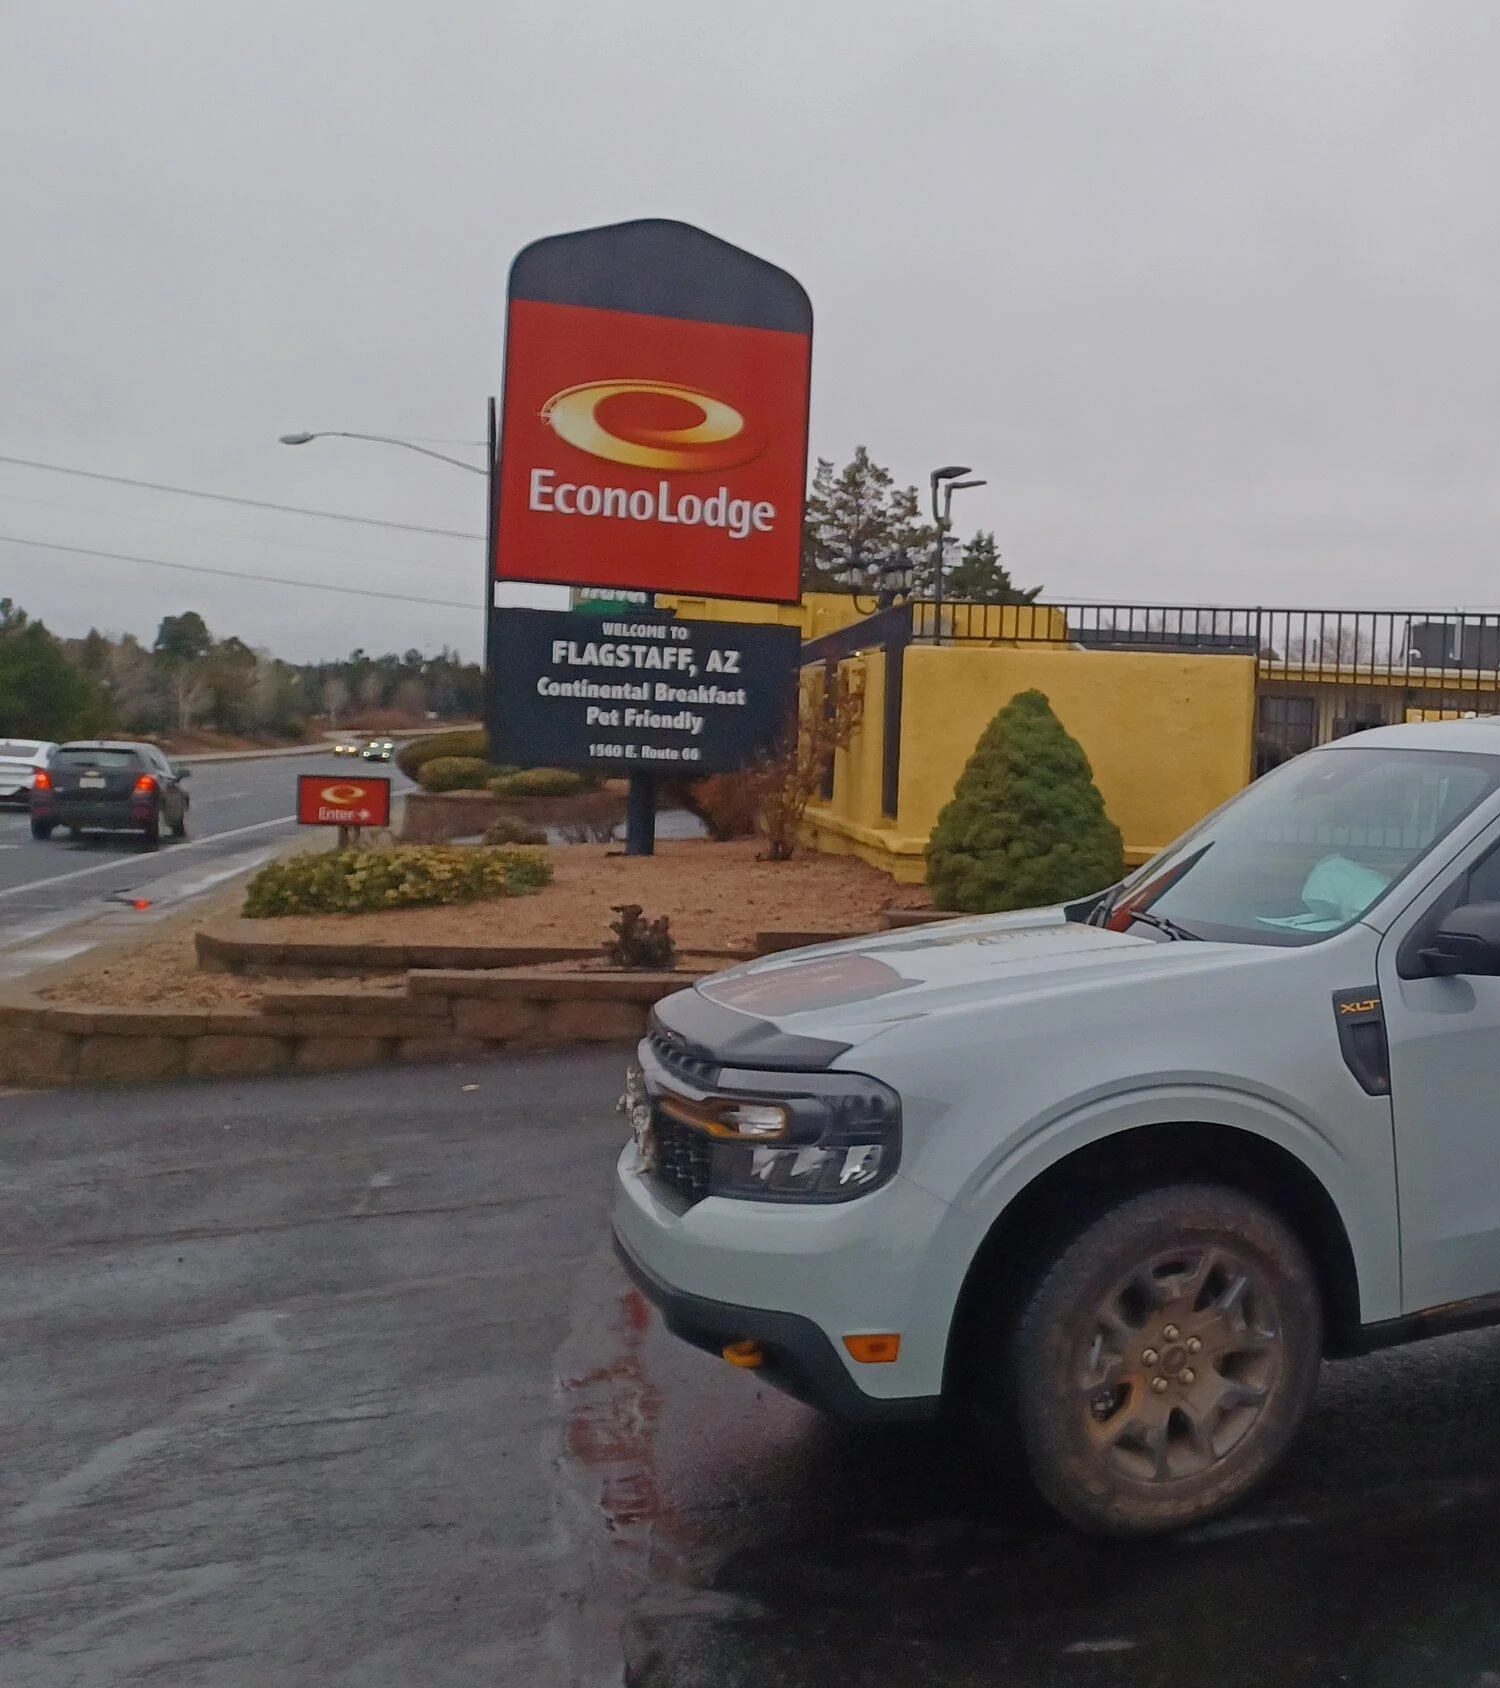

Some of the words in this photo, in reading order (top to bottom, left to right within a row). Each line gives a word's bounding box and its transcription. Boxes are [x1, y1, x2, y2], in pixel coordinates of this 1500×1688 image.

[528, 468, 776, 539] EconoLodge
[602, 622, 667, 639] WELCOME
[670, 626, 689, 640] TO
[552, 640, 696, 678] FLAGSTAFF,
[705, 650, 742, 674] AZ
[537, 676, 650, 700] Continental
[655, 682, 747, 705] Breakfast
[586, 706, 620, 726] Pet
[624, 708, 704, 735] Friendly
[625, 745, 637, 758] E.
[641, 746, 679, 760] Route
[682, 748, 700, 761] 66
[318, 807, 355, 820] Enter
[1340, 999, 1380, 1014] XLT
